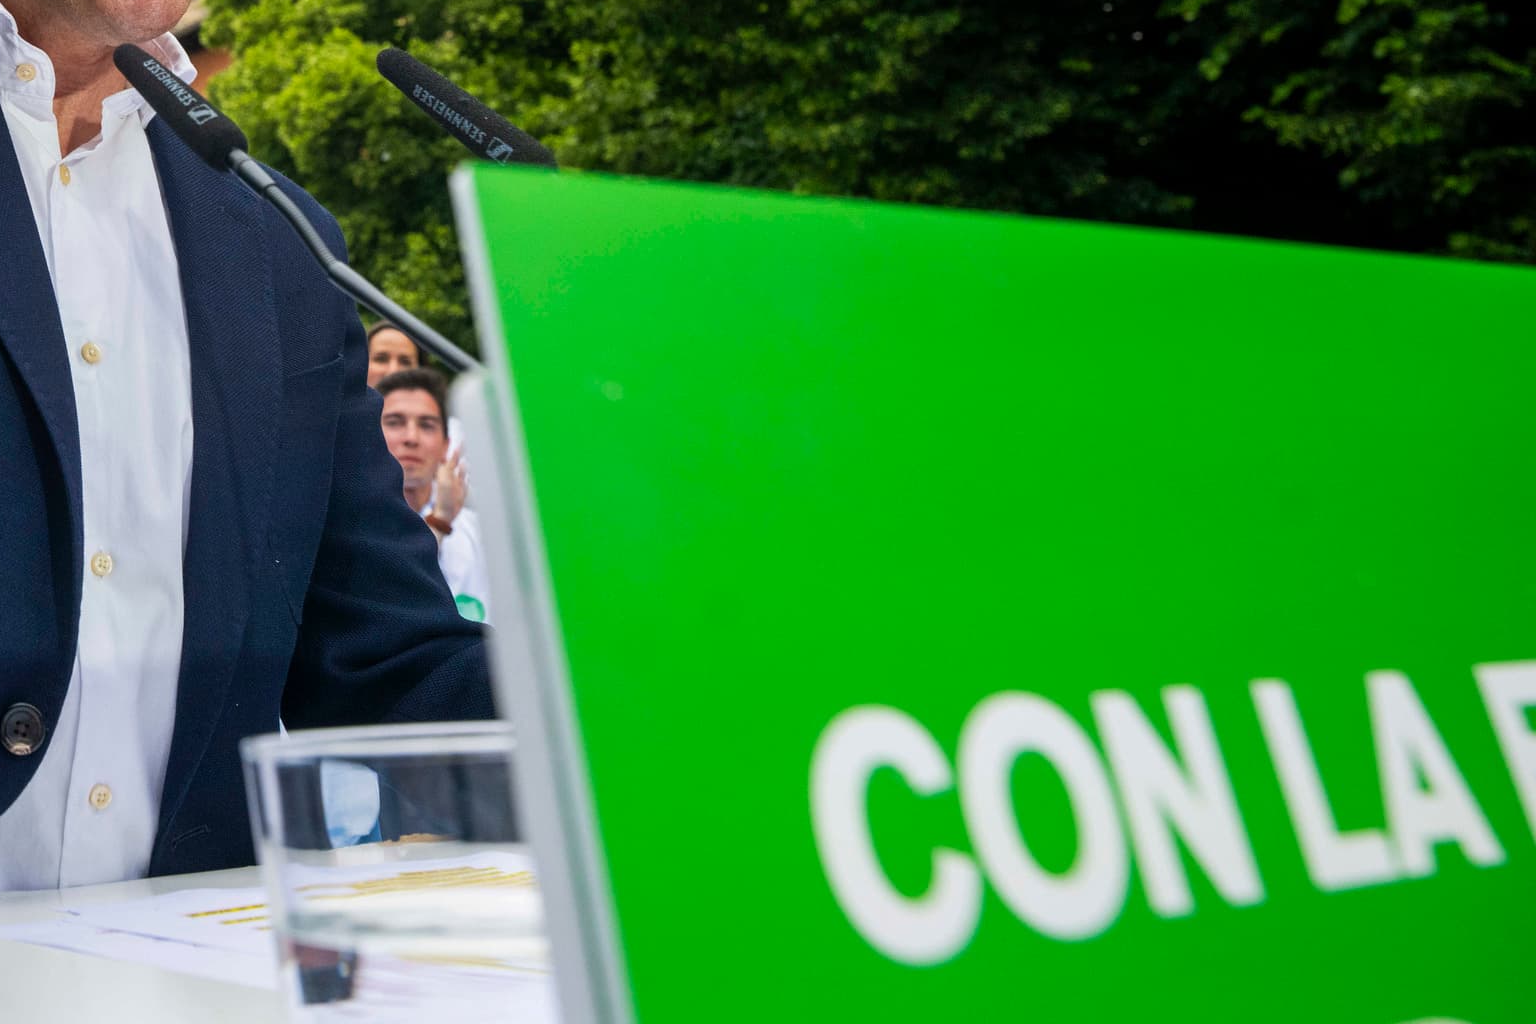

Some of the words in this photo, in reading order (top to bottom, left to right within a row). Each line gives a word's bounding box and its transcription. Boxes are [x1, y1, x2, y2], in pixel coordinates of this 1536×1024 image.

[143, 58, 197, 107] SENNHEISER
[412, 84, 487, 145] SENNHEISER
[807, 683, 1265, 966] CON
[1249, 668, 1507, 891] LA
